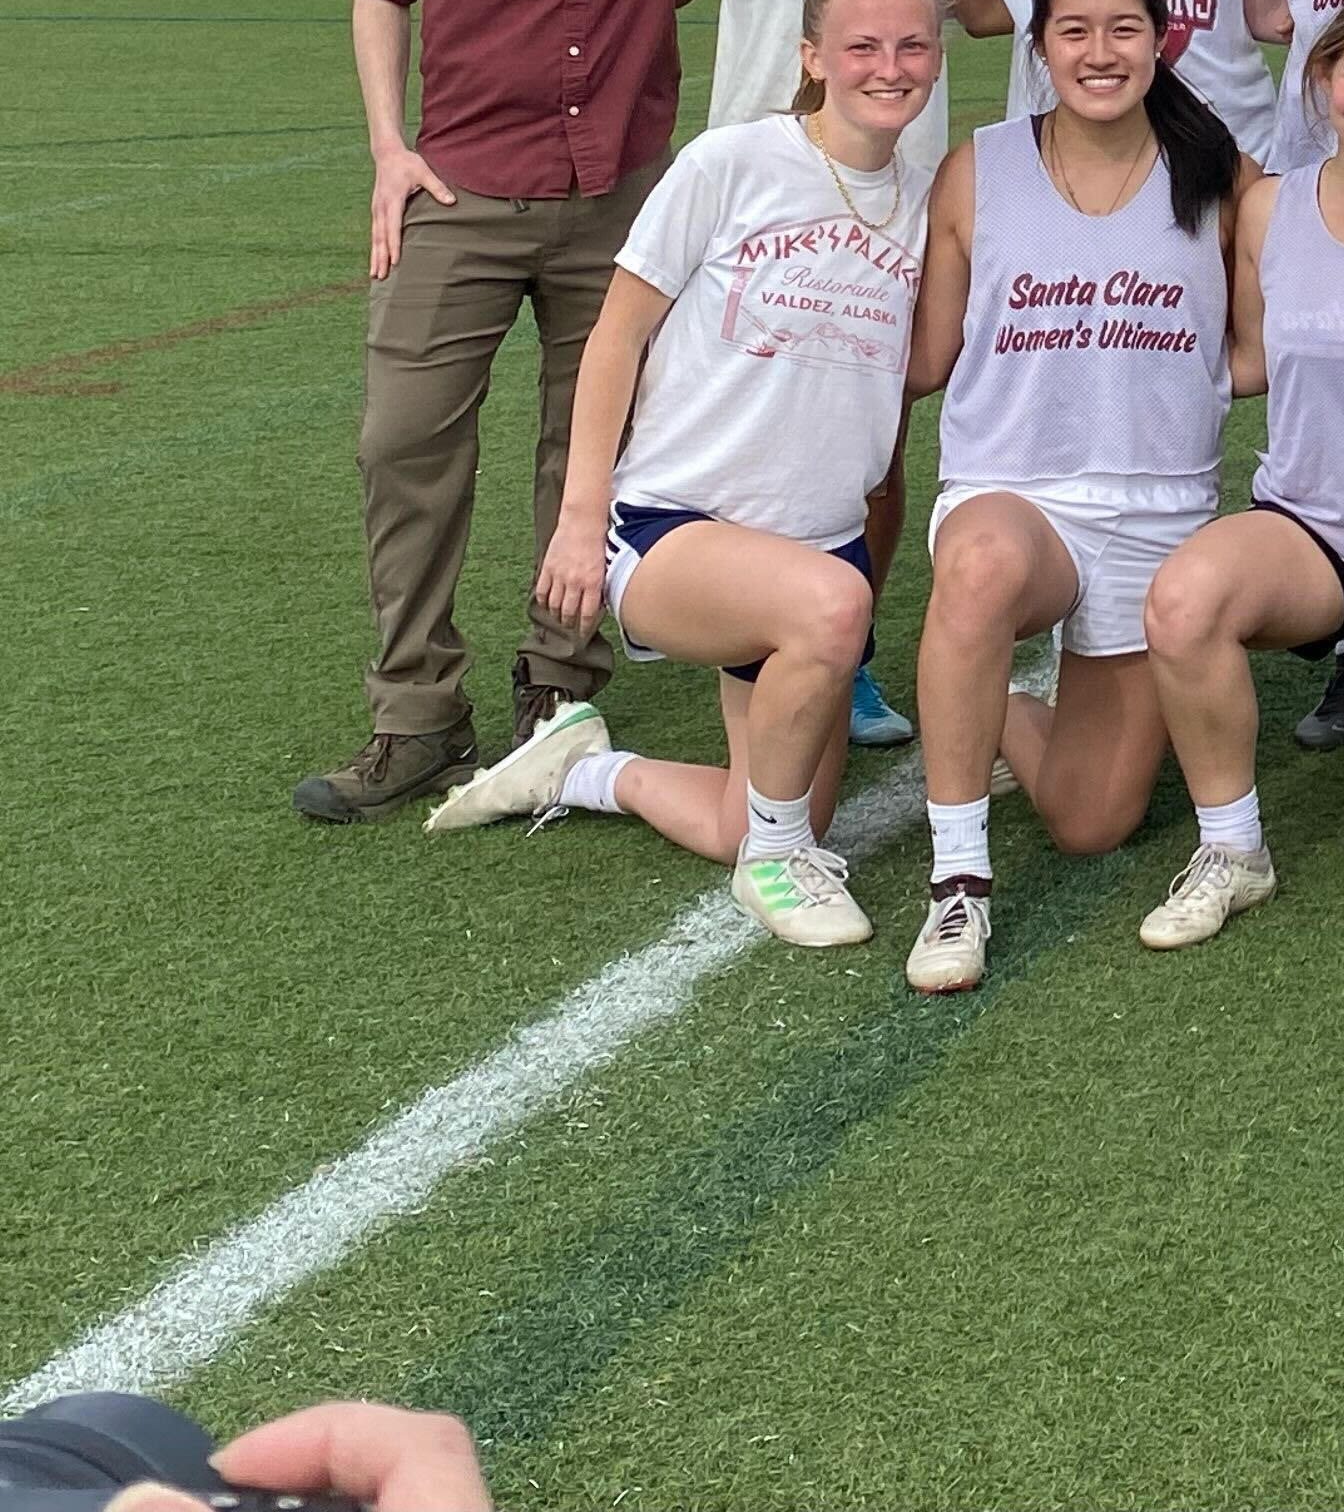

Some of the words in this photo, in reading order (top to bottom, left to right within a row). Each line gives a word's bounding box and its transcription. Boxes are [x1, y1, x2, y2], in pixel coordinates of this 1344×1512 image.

[738, 223, 841, 265] MIKE'S
[782, 265, 890, 303] Ristorante
[1008, 272, 1097, 309] Santa
[1103, 271, 1184, 308] Clara
[761, 291, 834, 316] VALDEZ,
[842, 304, 898, 327] ALASKA
[995, 319, 1092, 355] Women's
[1098, 319, 1197, 353] Ultimate
